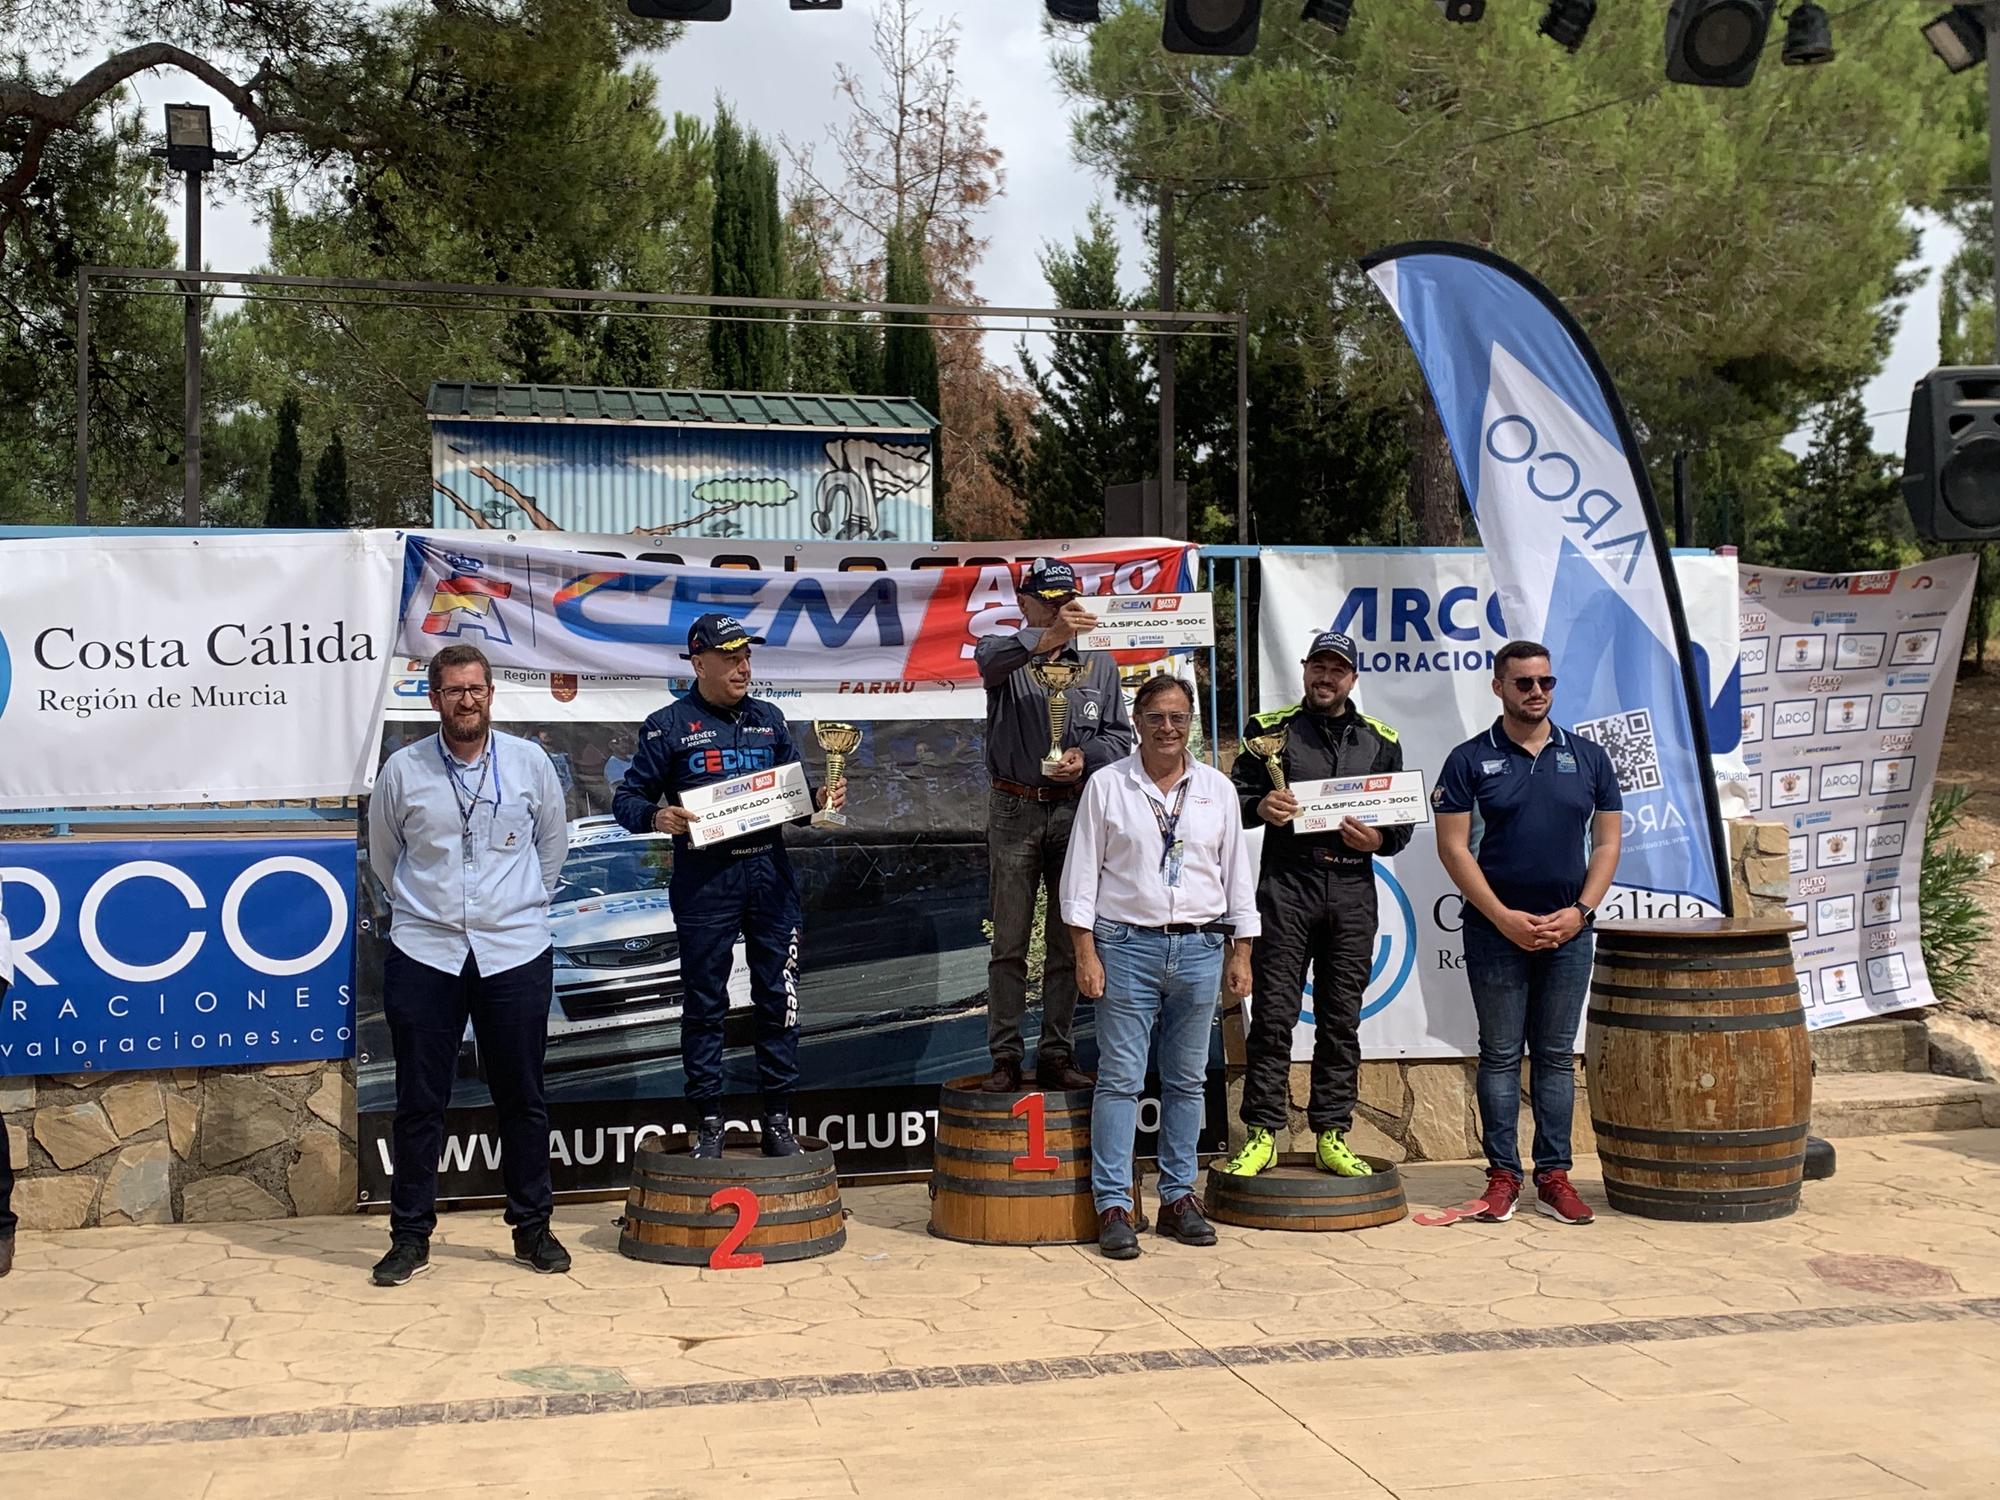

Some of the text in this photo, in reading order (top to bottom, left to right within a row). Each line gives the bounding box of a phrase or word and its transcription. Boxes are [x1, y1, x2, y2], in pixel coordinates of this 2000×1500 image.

[1044, 565, 1072, 577] ARCO
[1803, 577, 1850, 590] CEM
[553, 571, 905, 648] CEM
[1121, 600, 1152, 610] CEM
[1096, 620, 1168, 629] CLASIFICADO
[34, 620, 377, 671] Costa Cálida
[1319, 633, 1350, 646] ARCO
[504, 669, 547, 683] Región
[1809, 676, 1843, 685] AUTO
[752, 687, 802, 700] de Deportes
[838, 681, 916, 694] FARMU
[38, 684, 289, 719] Región de Murcia
[1776, 711, 1811, 725] ARCO
[681, 730, 718, 744] PYRÉNÉES
[1882, 734, 1913, 744] AUTO
[1334, 782, 1364, 792] CEM
[1824, 774, 1859, 787] ARCO
[724, 782, 752, 796] CEM
[705, 797, 770, 820] CLASIFICADO
[1311, 799, 1381, 812] CLASIFICADO
[1869, 833, 1901, 848] ARCO
[1800, 875, 1826, 886] AUTO
[1870, 929, 1896, 941] AUTO
[1012, 1092, 1060, 1171] 1
[709, 1186, 764, 1270] 2
